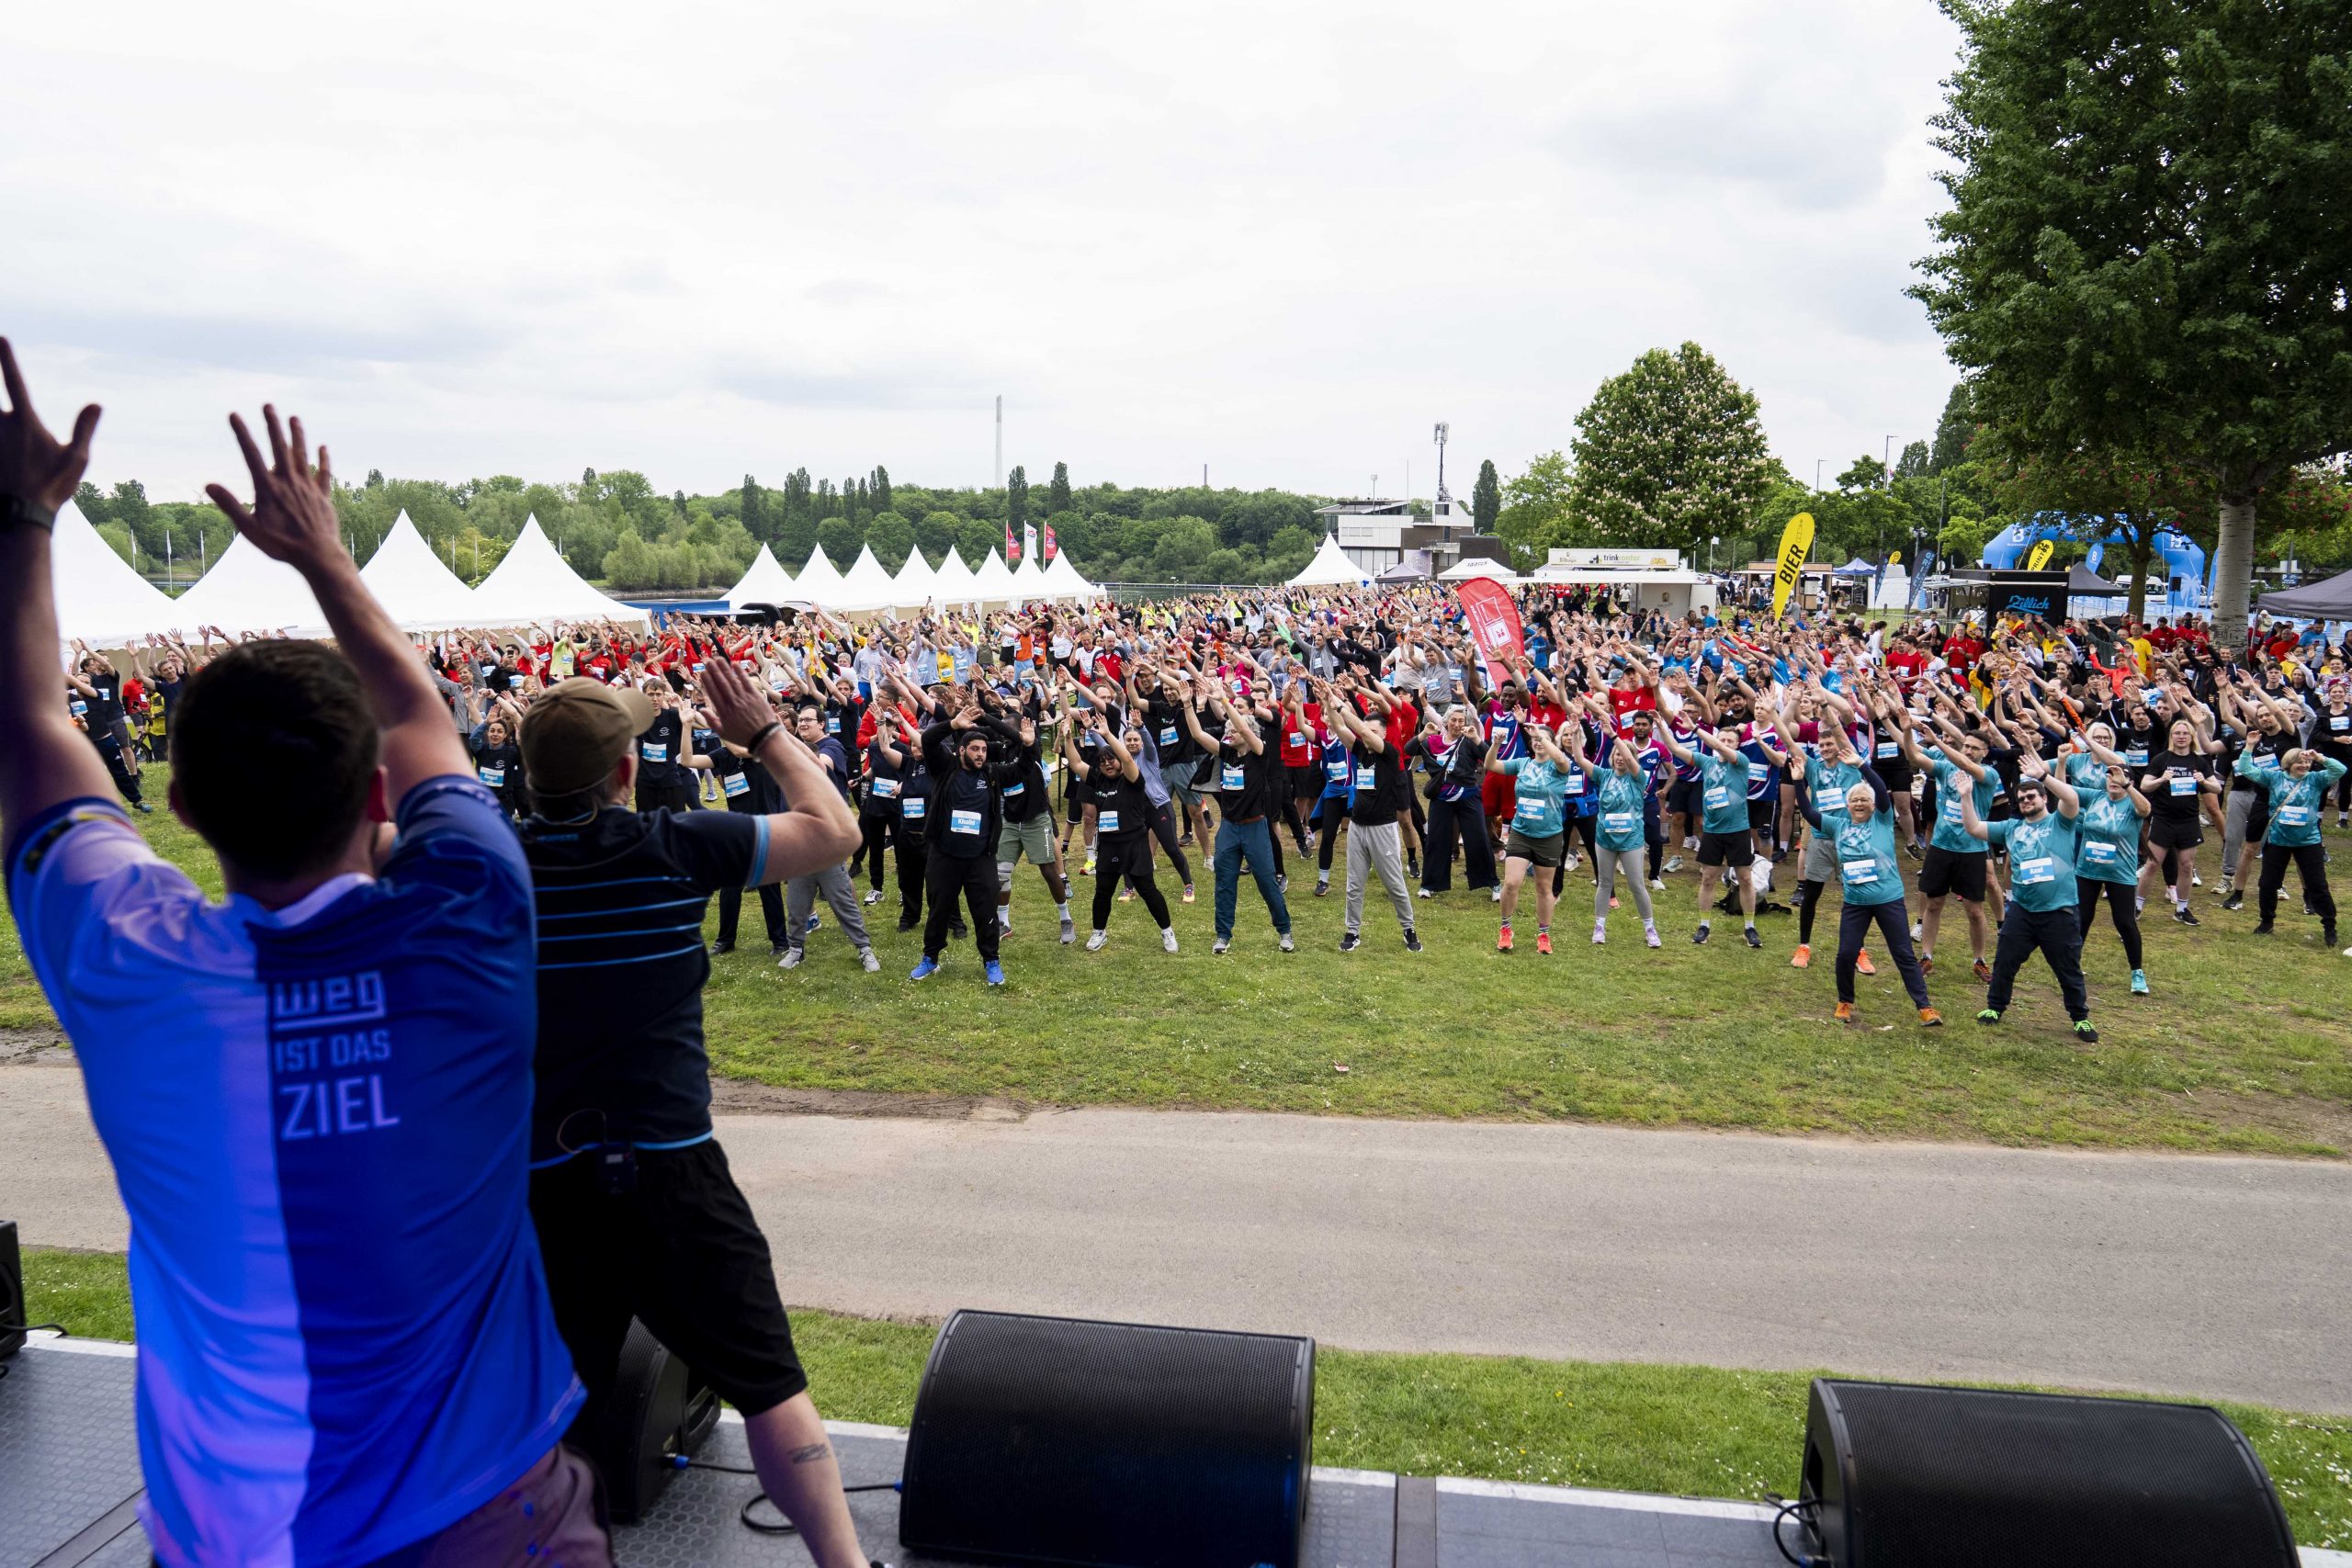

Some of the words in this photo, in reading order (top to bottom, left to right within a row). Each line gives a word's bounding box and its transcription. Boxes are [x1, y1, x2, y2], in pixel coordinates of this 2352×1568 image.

[1779, 543, 1804, 586] BIER
[1912, 551, 1933, 587] GRILL
[2008, 594, 2051, 610] Zillich
[957, 816, 976, 826] Khalid
[274, 1036, 322, 1074] IST
[329, 1029, 392, 1068] DAS
[279, 1072, 401, 1142] ZIEL
